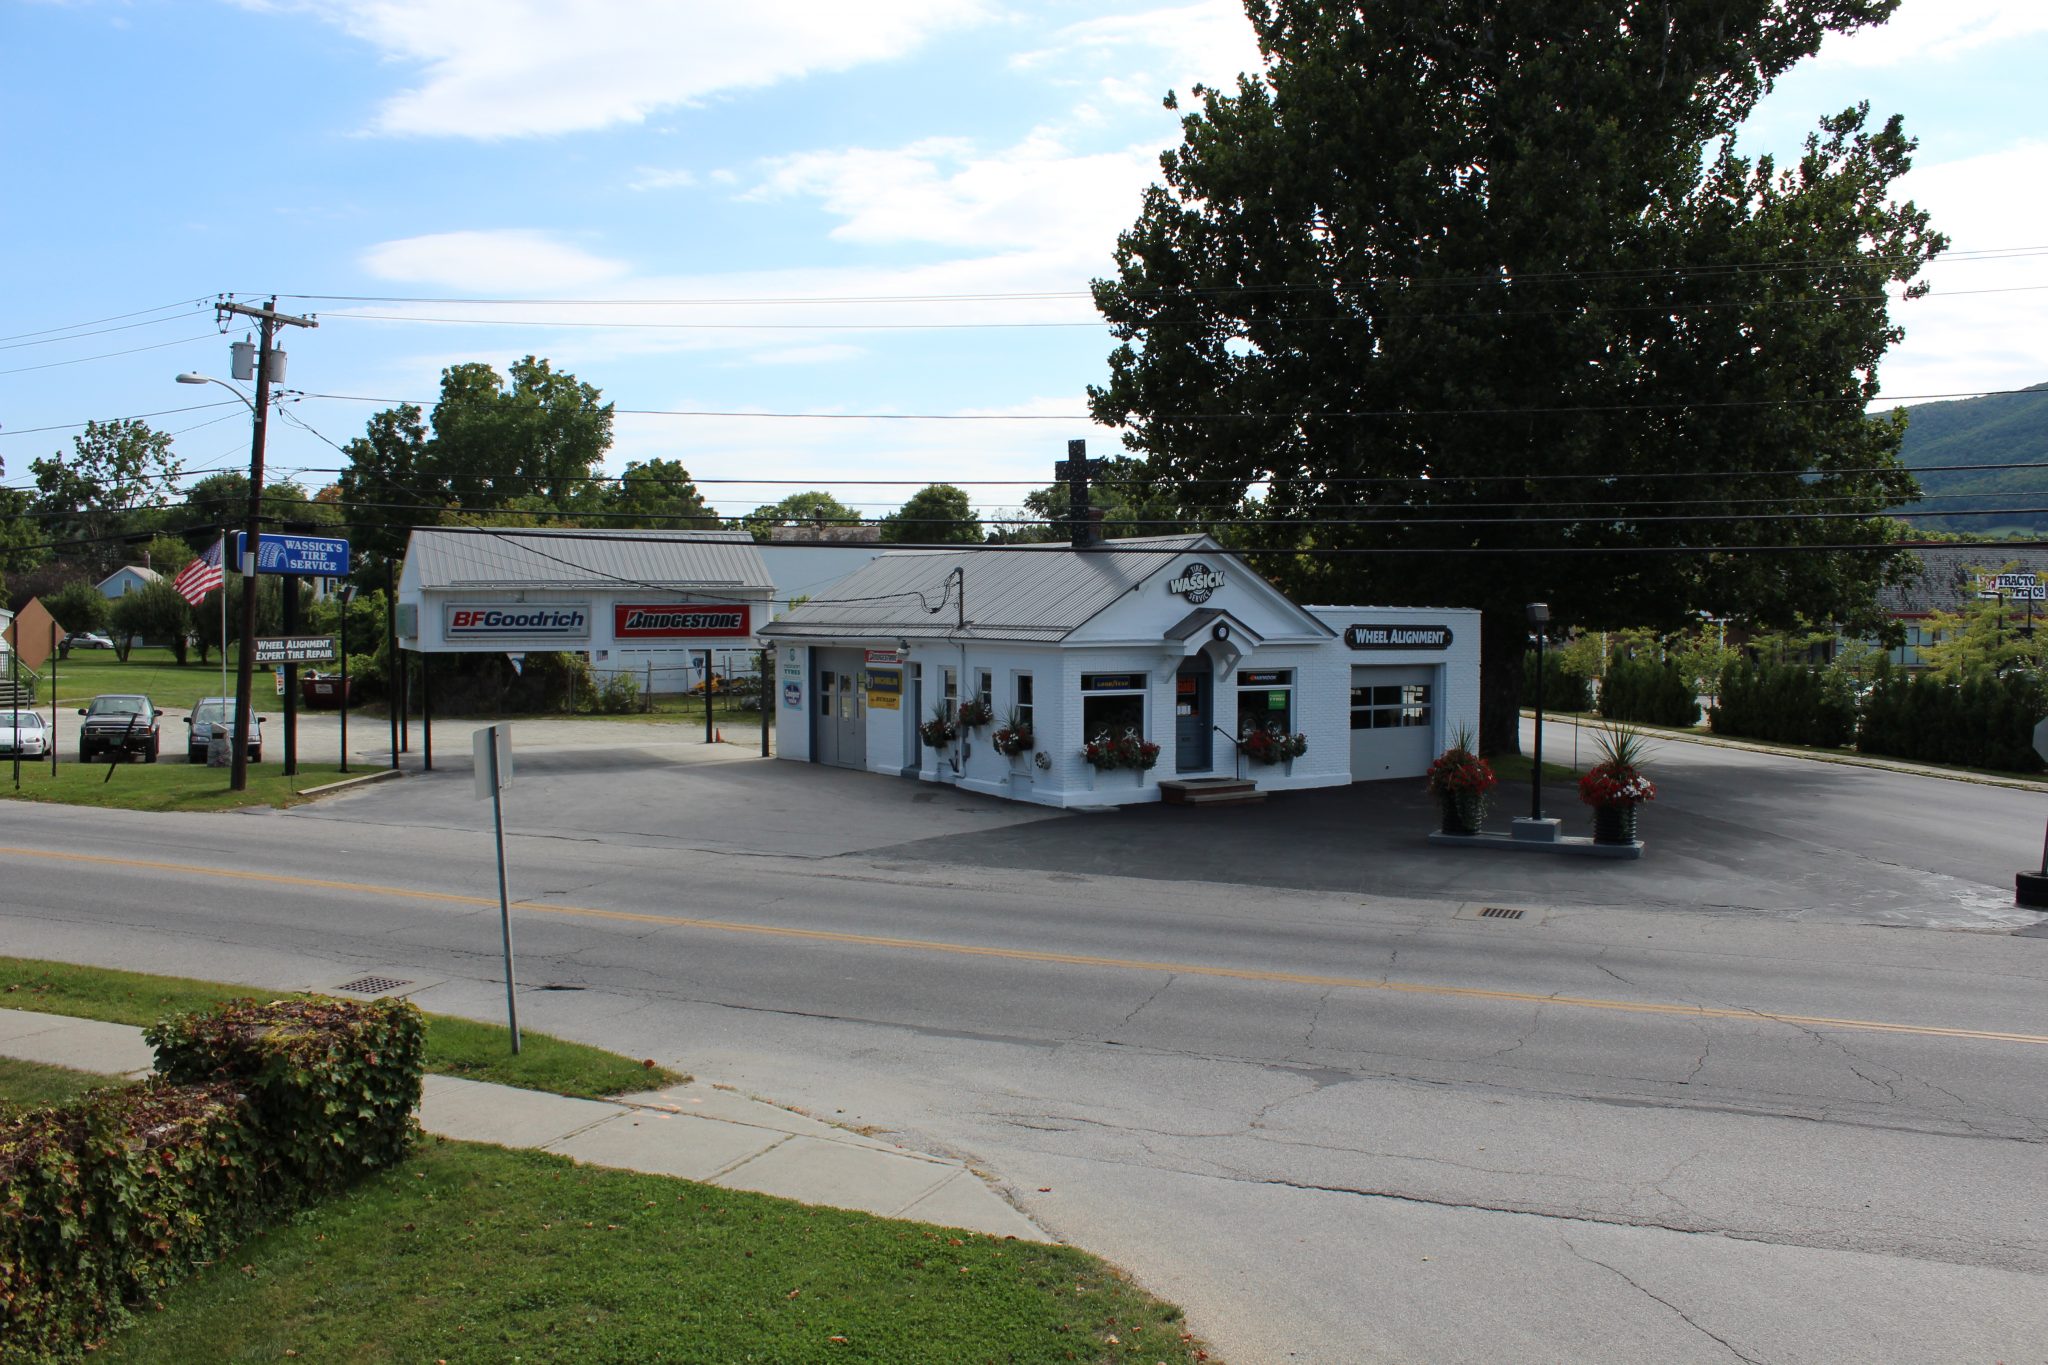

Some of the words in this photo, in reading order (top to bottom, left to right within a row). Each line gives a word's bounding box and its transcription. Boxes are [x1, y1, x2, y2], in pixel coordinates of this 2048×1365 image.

[285, 540, 343, 553] WASSICK'S
[301, 550, 328, 561] TIRE
[290, 560, 337, 571] SERVICE
[1170, 571, 1225, 594] WASSICK
[1997, 575, 2043, 586] TRACTO
[1188, 590, 1212, 603] SERVICE
[452, 610, 585, 627] BFGoodrich
[625, 610, 742, 629] BRIDGESTONE
[1355, 628, 1389, 644] WHEEL
[1390, 628, 1445, 644] ALIGNMENT
[257, 640, 285, 650] WHEEL
[286, 639, 331, 649] ALIGNMENT
[256, 651, 286, 661] EXPERT
[287, 650, 305, 660] TIRE
[306, 649, 333, 658] REPAIR
